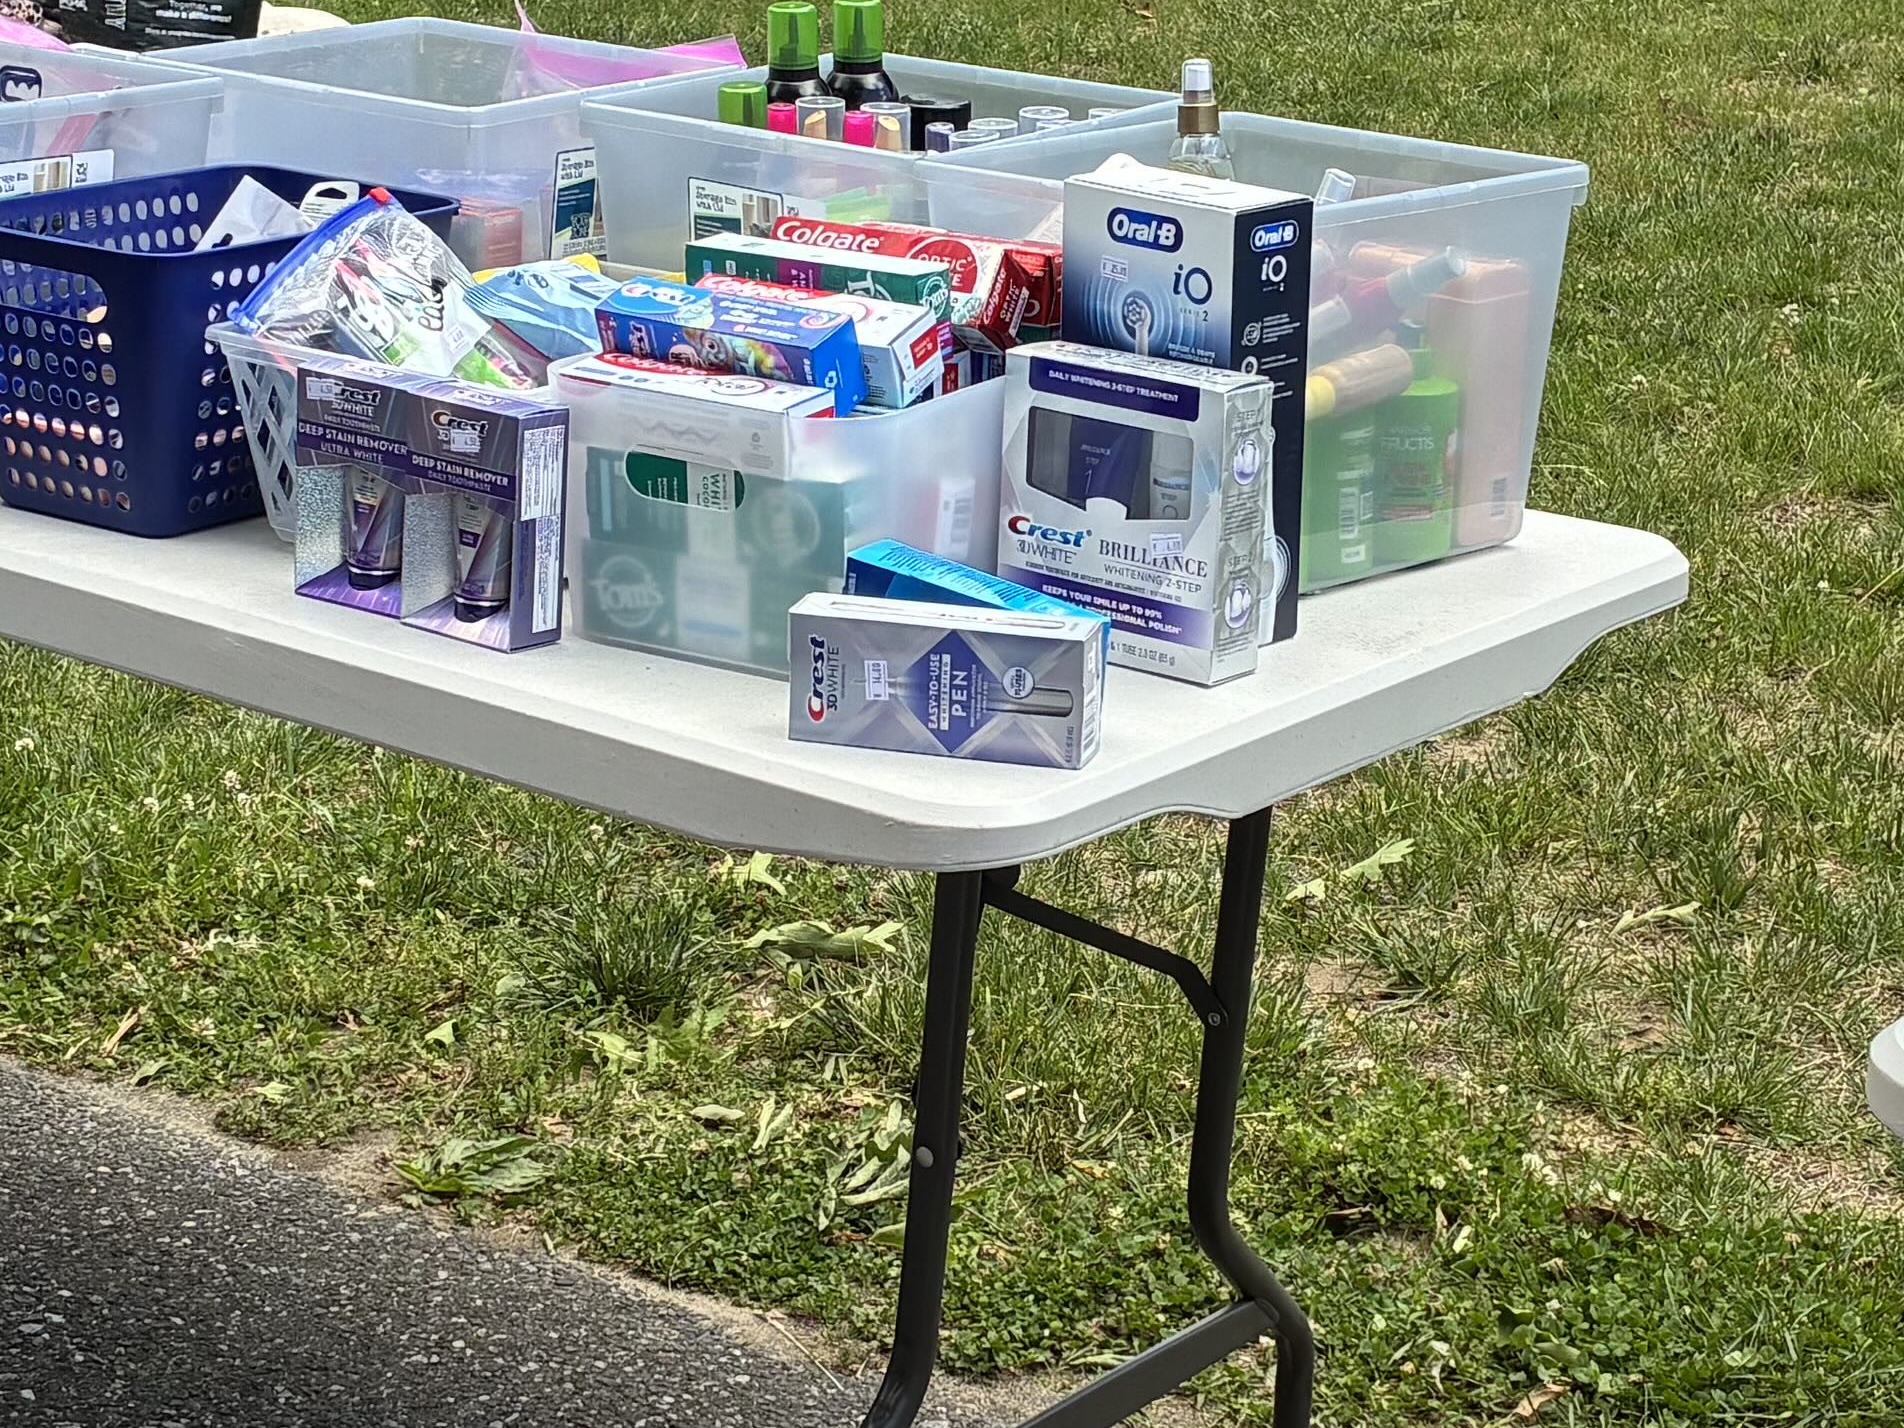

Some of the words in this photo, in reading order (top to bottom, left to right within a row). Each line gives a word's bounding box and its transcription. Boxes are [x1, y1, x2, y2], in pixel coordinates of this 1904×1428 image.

[776, 222, 880, 253] Colgate
[1111, 213, 1178, 247] Oral-B
[1253, 225, 1294, 248] Oral-B
[1261, 254, 1288, 283] iO
[1172, 264, 1213, 306] iO
[298, 421, 324, 437] DEEP
[325, 426, 356, 446] STAIN
[356, 434, 409, 456] REMOVER
[431, 409, 489, 436] Crest
[320, 440, 351, 458] ULTRA
[353, 447, 384, 465] WHITE
[1379, 436, 1435, 451] FRUCTIS
[411, 453, 436, 470] DEEP
[436, 459, 463, 477] STAIN
[463, 466, 509, 488] REMOVER
[1008, 515, 1086, 549] Crest
[1099, 539, 1208, 578] BRILLIANCE
[1104, 563, 1163, 587] WHITENING
[1165, 579, 1202, 594] 2-STEP
[1069, 589, 1092, 604] YOUR
[1093, 595, 1117, 610] SMILE
[1118, 601, 1131, 612] UP
[1131, 603, 1144, 615] TO
[807, 634, 828, 723] Crest
[951, 670, 969, 717] PEN
